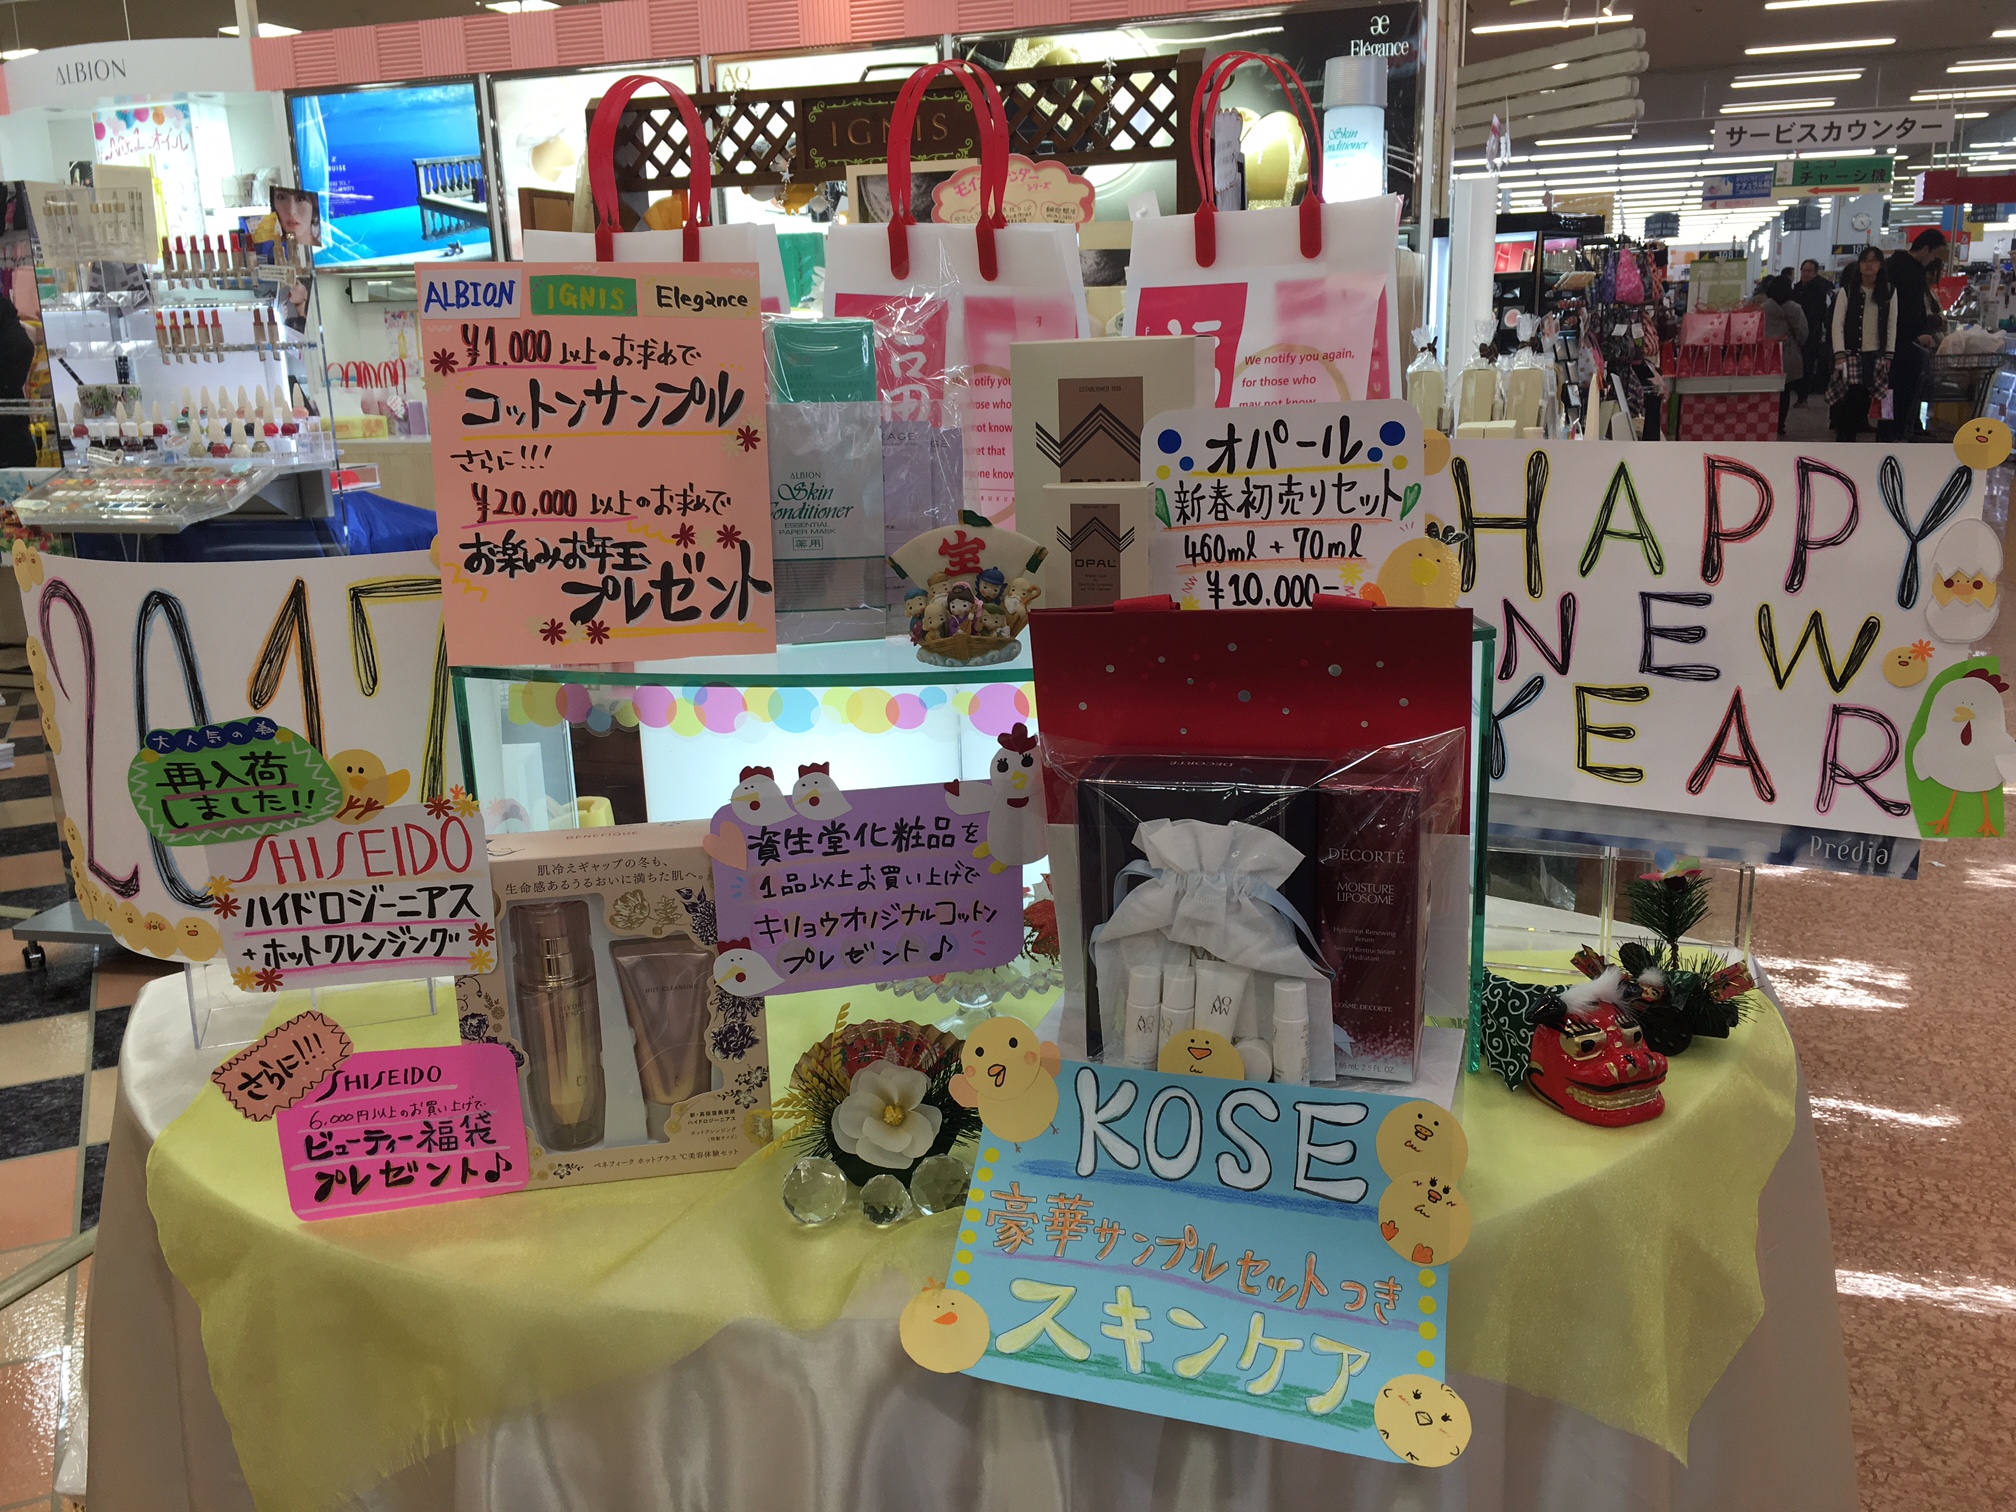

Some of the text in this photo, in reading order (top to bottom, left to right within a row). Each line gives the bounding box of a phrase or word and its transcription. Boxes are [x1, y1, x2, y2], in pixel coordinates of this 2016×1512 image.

[56, 58, 127, 85] ALBION
[722, 66, 751, 83] AQ
[1328, 127, 1358, 141] Skin
[1725, 117, 1943, 148] サービスカウンター
[424, 279, 515, 312] ALBION
[546, 283, 625, 310] IGNIS
[656, 285, 748, 311] Elegance
[1245, 348, 1354, 366] We notify you again,
[1242, 375, 1316, 388] for those who
[461, 370, 745, 431] コットンサンプル
[992, 399, 1012, 409] who
[988, 422, 1013, 432] know
[988, 445, 1005, 456] that
[1205, 415, 1363, 474] オパール
[777, 482, 834, 501] Skin
[790, 471, 821, 479] ALBION
[590, 482, 731, 516] 以上のお求めで
[1174, 469, 1402, 525] 新春初売りセット
[1184, 530, 1256, 567] 460ml
[1292, 523, 1363, 563] 70ml
[1451, 449, 1974, 610] HAPPY
[459, 526, 652, 579] お楽しみお年玉
[938, 530, 986, 577] 宝
[1075, 559, 1114, 568] OPAL
[561, 539, 773, 626] プレゼント
[1498, 592, 1882, 694] NEW
[1476, 676, 1912, 815] YEAR
[156, 751, 287, 791] 再入荷
[161, 789, 315, 829] しました!!
[228, 816, 473, 884] SHISEIDO
[748, 816, 980, 866] 資生堂化粧品を
[1810, 835, 1888, 865] Prédia
[537, 856, 669, 876] 肌冷えギャップの冬も、
[759, 860, 980, 898] 1品以上お買い上げで
[1337, 882, 1394, 894] MOISTURE
[1337, 892, 1394, 905] LIPOSOME
[245, 885, 481, 928] ハイドロジーニアス
[754, 901, 997, 944] キリョウオリジナルコットン
[1333, 927, 1397, 938] Hydration Renewing
[783, 939, 919, 975] プレゼント
[1349, 954, 1379, 962] Hydratant
[661, 984, 698, 992] CLEANSING
[315, 1065, 442, 1102] SHISEIDO
[304, 1111, 496, 1161] ビューティー福袋
[687, 1116, 736, 1125] ハイドロジーニアス
[690, 1127, 736, 1136] ホットクレンジング
[1074, 1066, 1369, 1204] KOSE
[314, 1156, 478, 1204] プレゼント
[986, 1183, 1403, 1325] 豪華サンプルセットつき
[995, 1278, 1371, 1416] スキンケア
